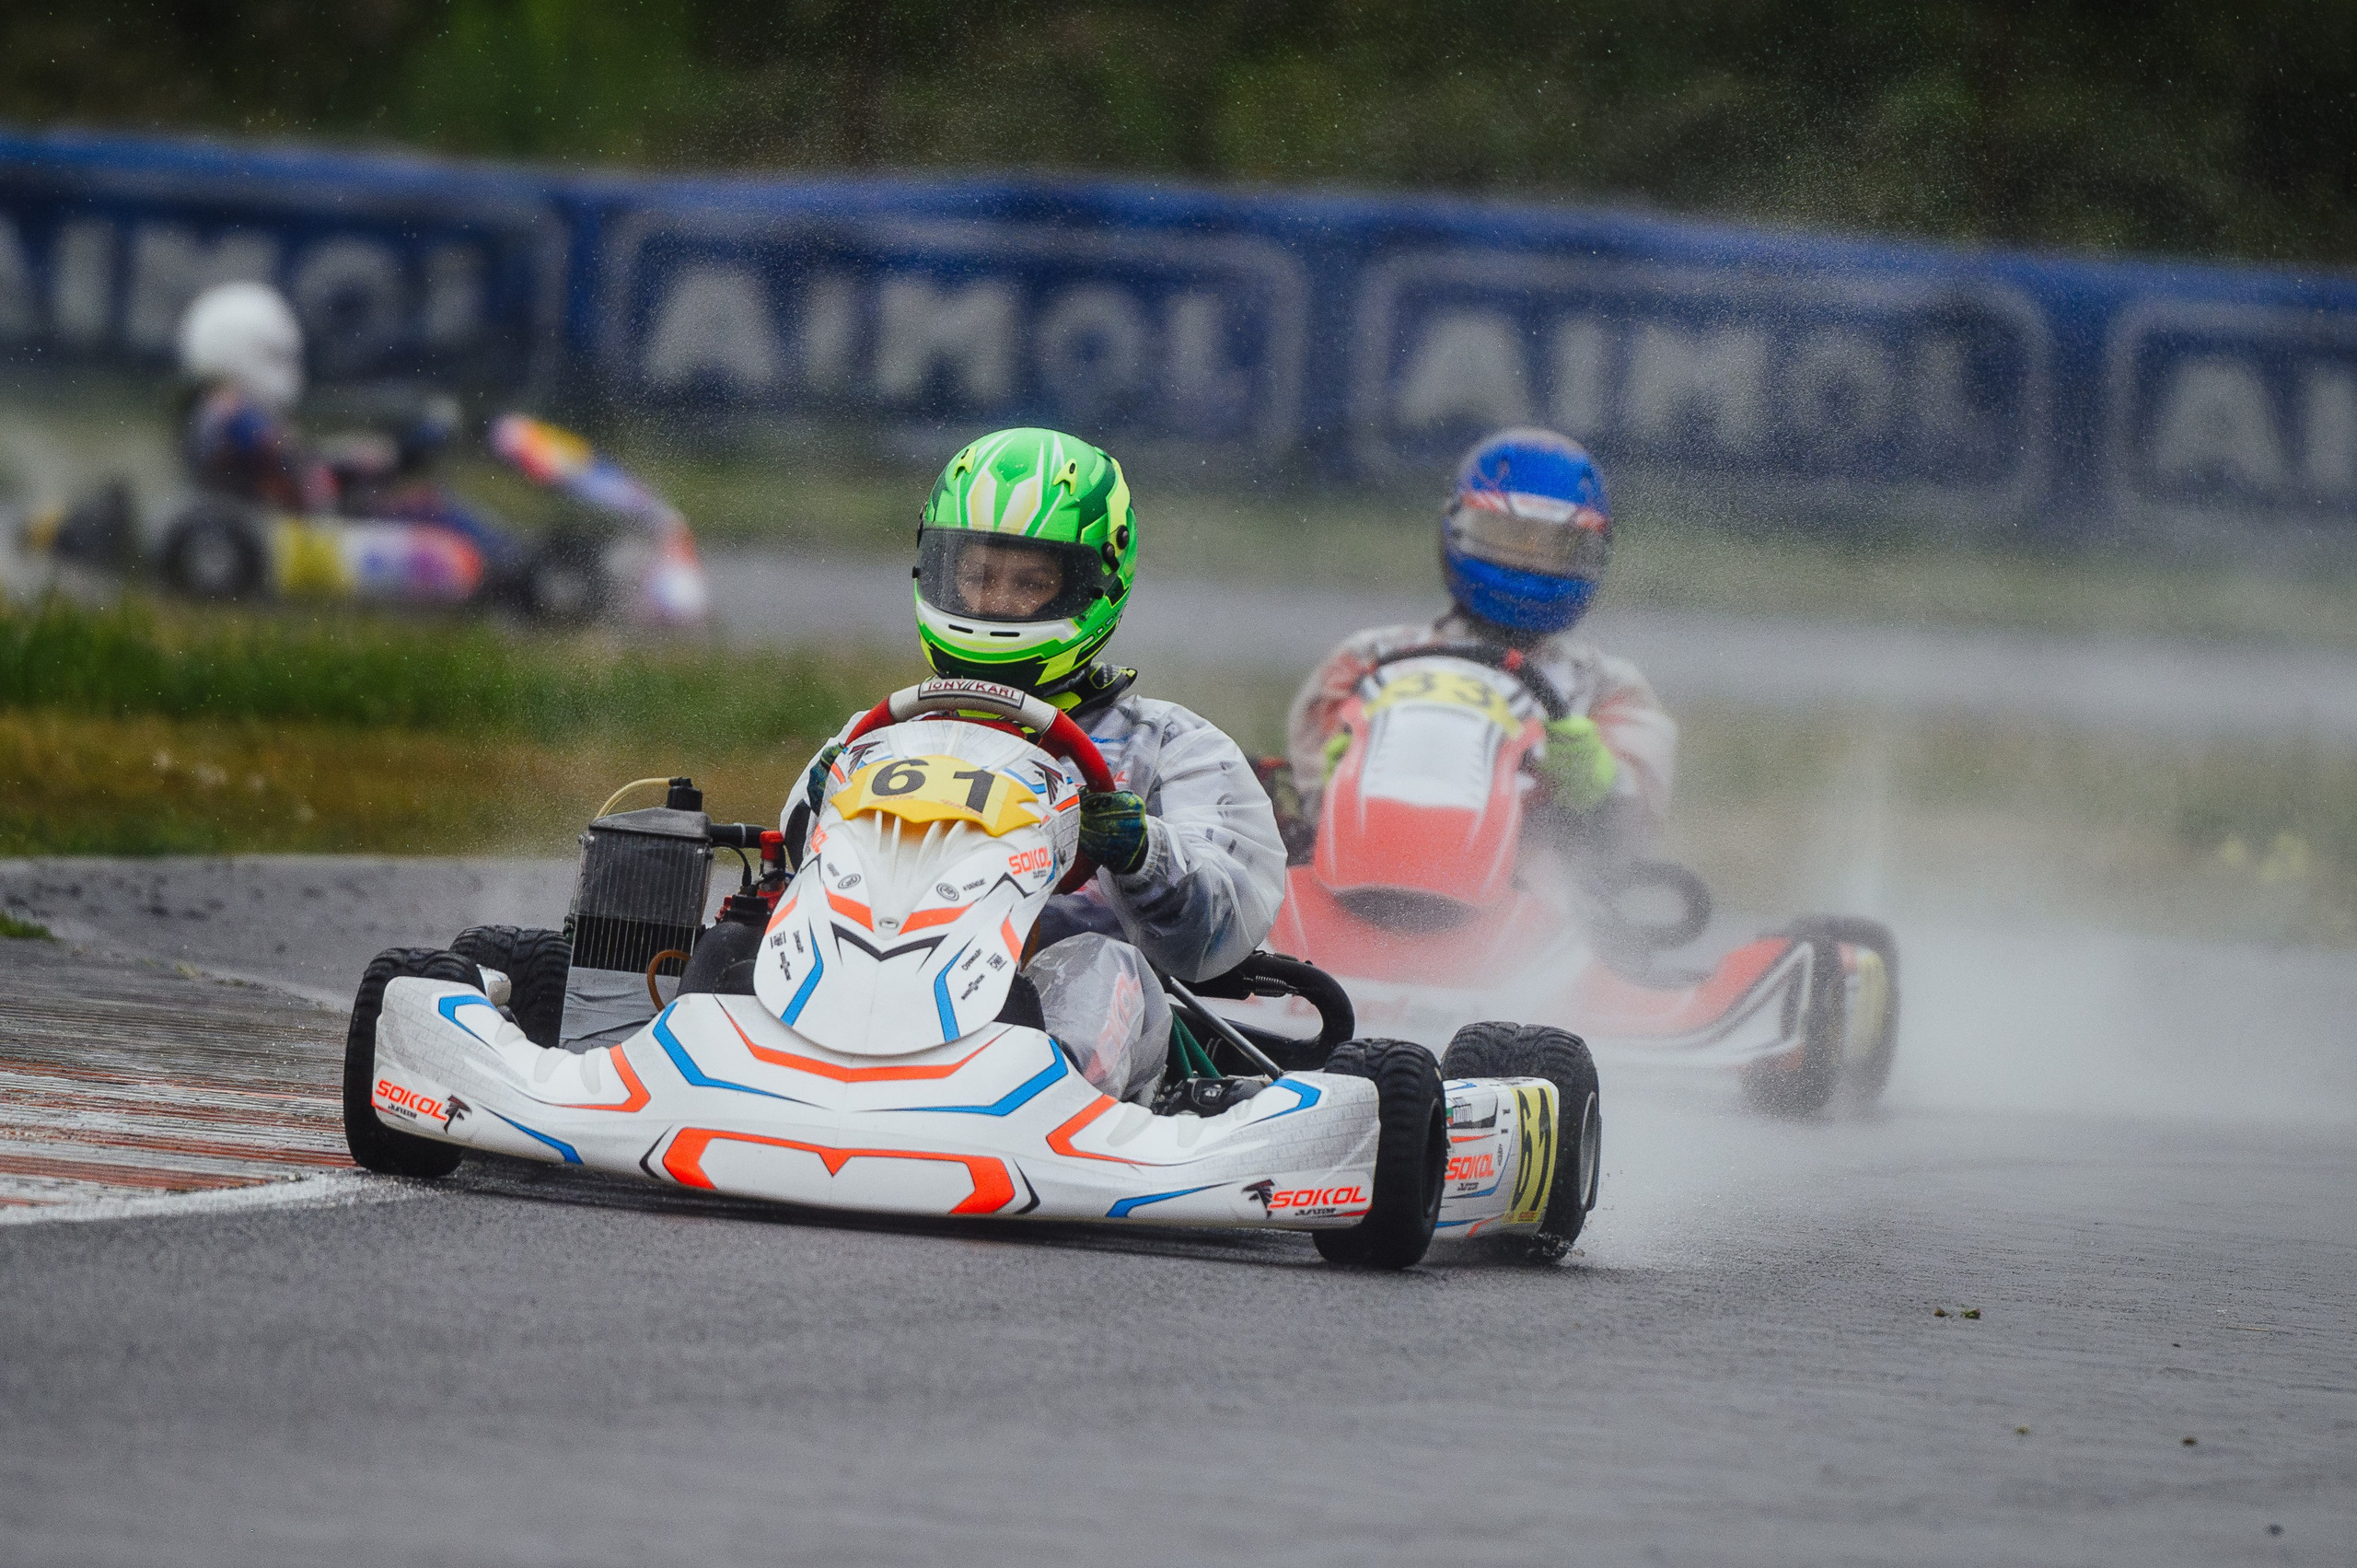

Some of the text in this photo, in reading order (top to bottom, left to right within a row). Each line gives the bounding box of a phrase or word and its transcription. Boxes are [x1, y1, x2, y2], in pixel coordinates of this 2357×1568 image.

[871, 759, 995, 814] 61
[1008, 846, 1051, 875] SOKOL
[375, 1079, 447, 1121] SOKOL
[1445, 1153, 1494, 1180] SOKOL
[1268, 1186, 1367, 1209] SOKOL
